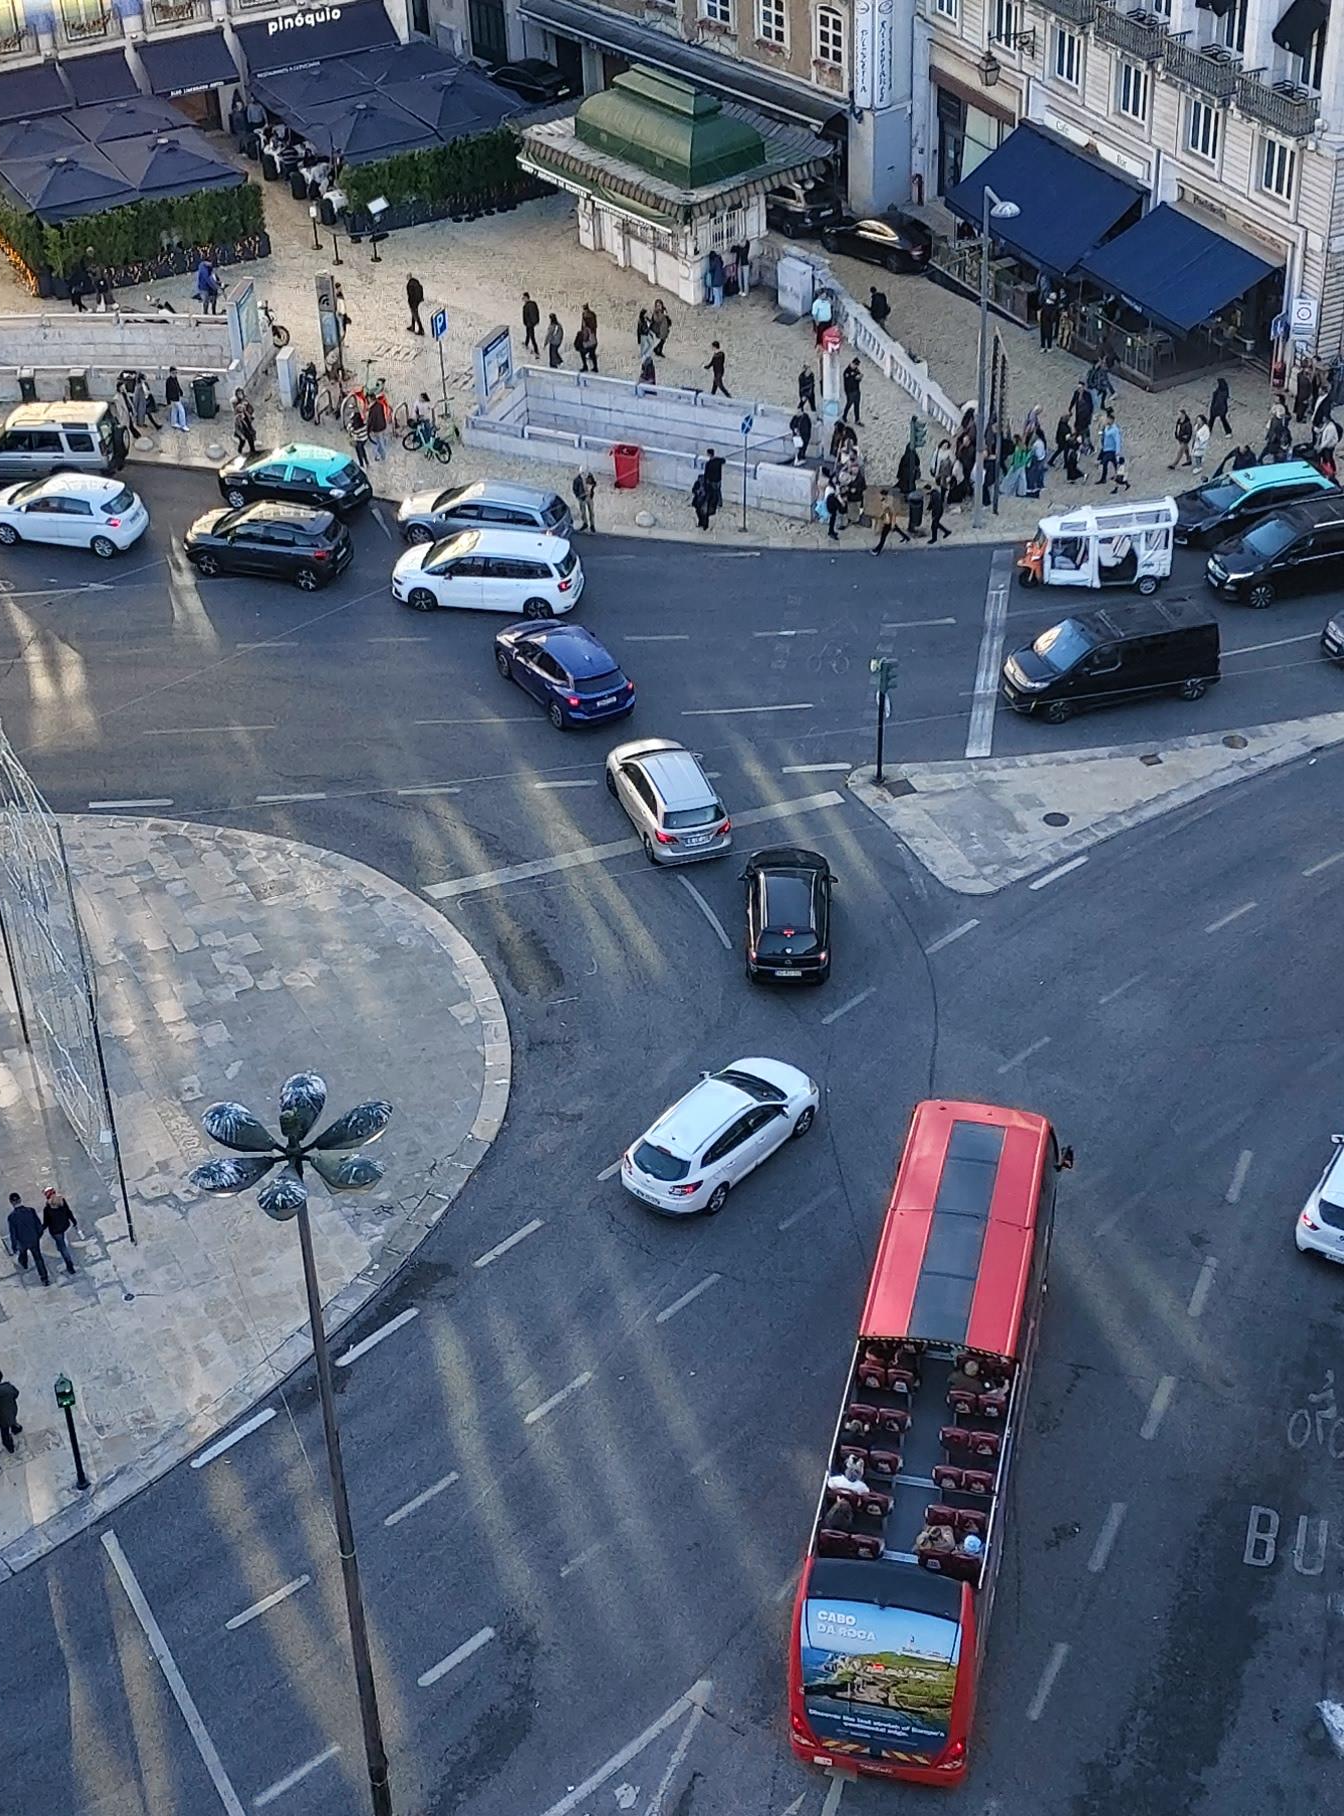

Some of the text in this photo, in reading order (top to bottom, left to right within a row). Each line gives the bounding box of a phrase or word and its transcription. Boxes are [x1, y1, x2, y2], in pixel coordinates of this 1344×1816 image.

[268, 7, 342, 36] pinóquio
[436, 312, 444, 335] P
[817, 1609, 857, 1626] CABO
[815, 1622, 878, 1642] DA ROCA
[842, 1714, 857, 1724] the
